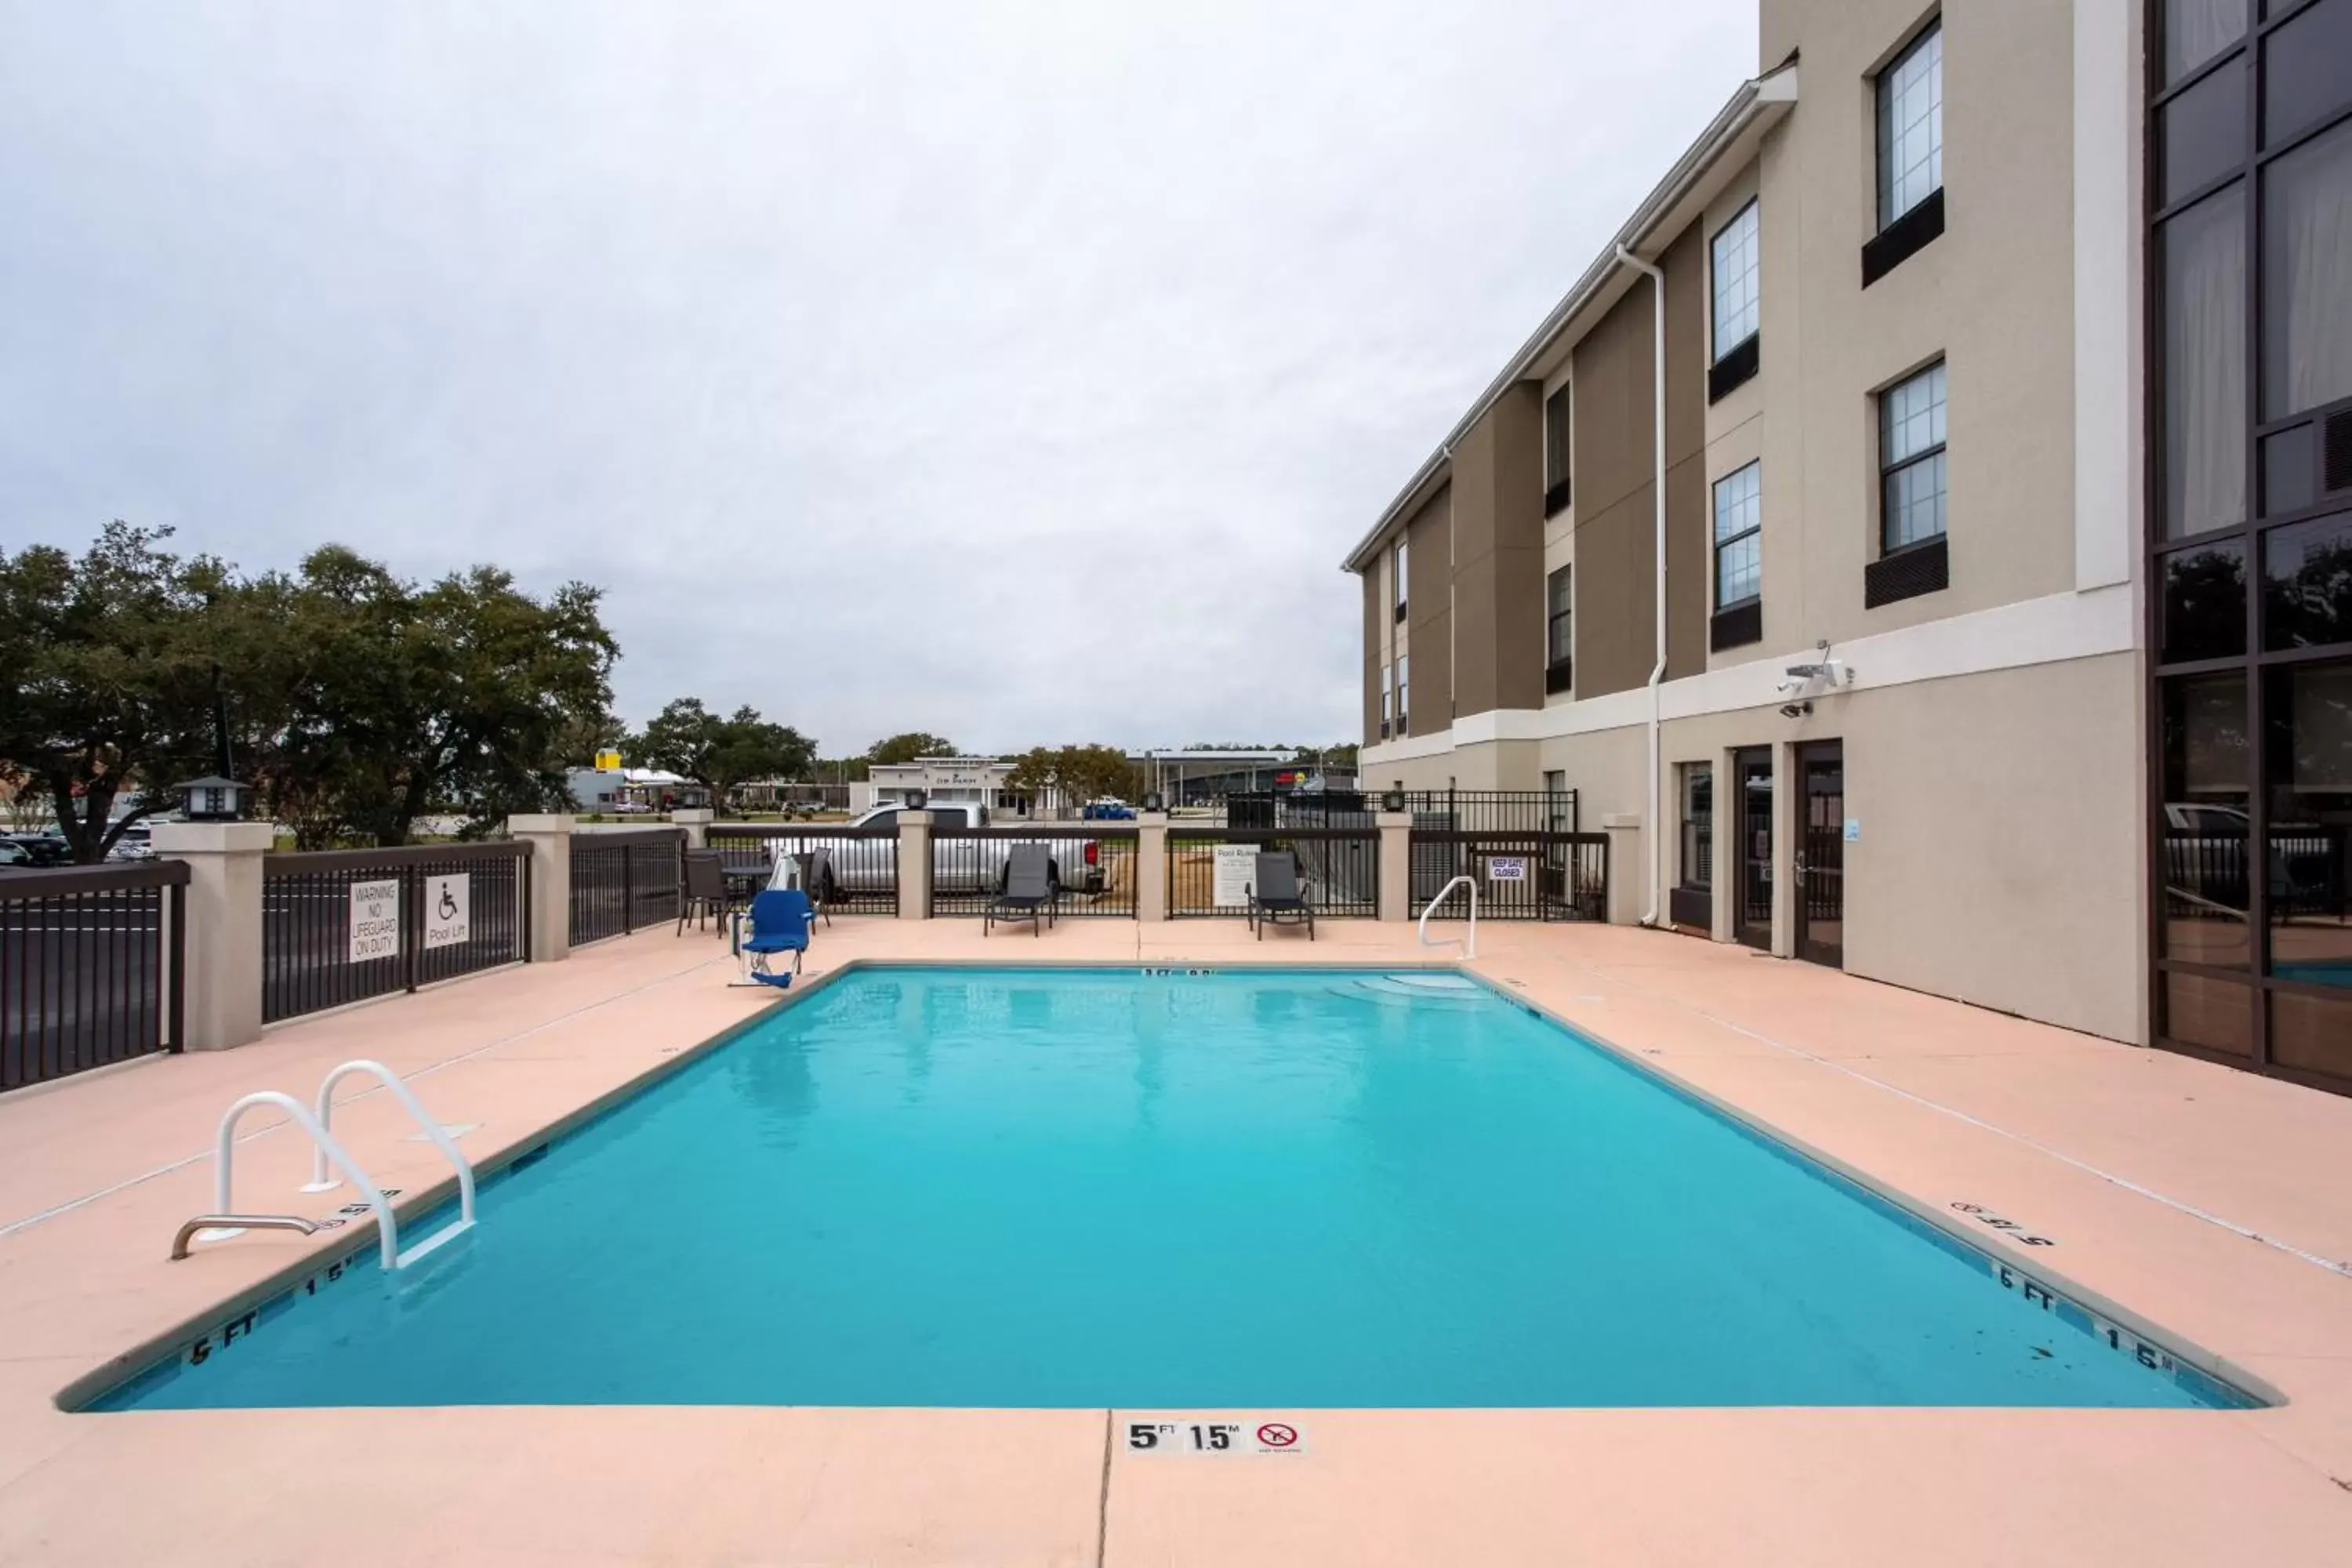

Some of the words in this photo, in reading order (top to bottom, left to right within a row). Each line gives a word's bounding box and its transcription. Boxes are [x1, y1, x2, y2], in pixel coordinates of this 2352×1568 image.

[1494, 868, 1520, 877] CLOSED
[355, 884, 395, 902] WARNING
[368, 903, 382, 918] NO
[352, 918, 396, 938] LIFEGUARD
[430, 928, 448, 942] Pool
[452, 924, 466, 938] Lift
[355, 942, 368, 956] ON
[370, 936, 393, 953] DUTY
[2024, 1283, 2053, 1311] FT
[190, 1340, 212, 1365] 5
[224, 1309, 257, 1348] FT
